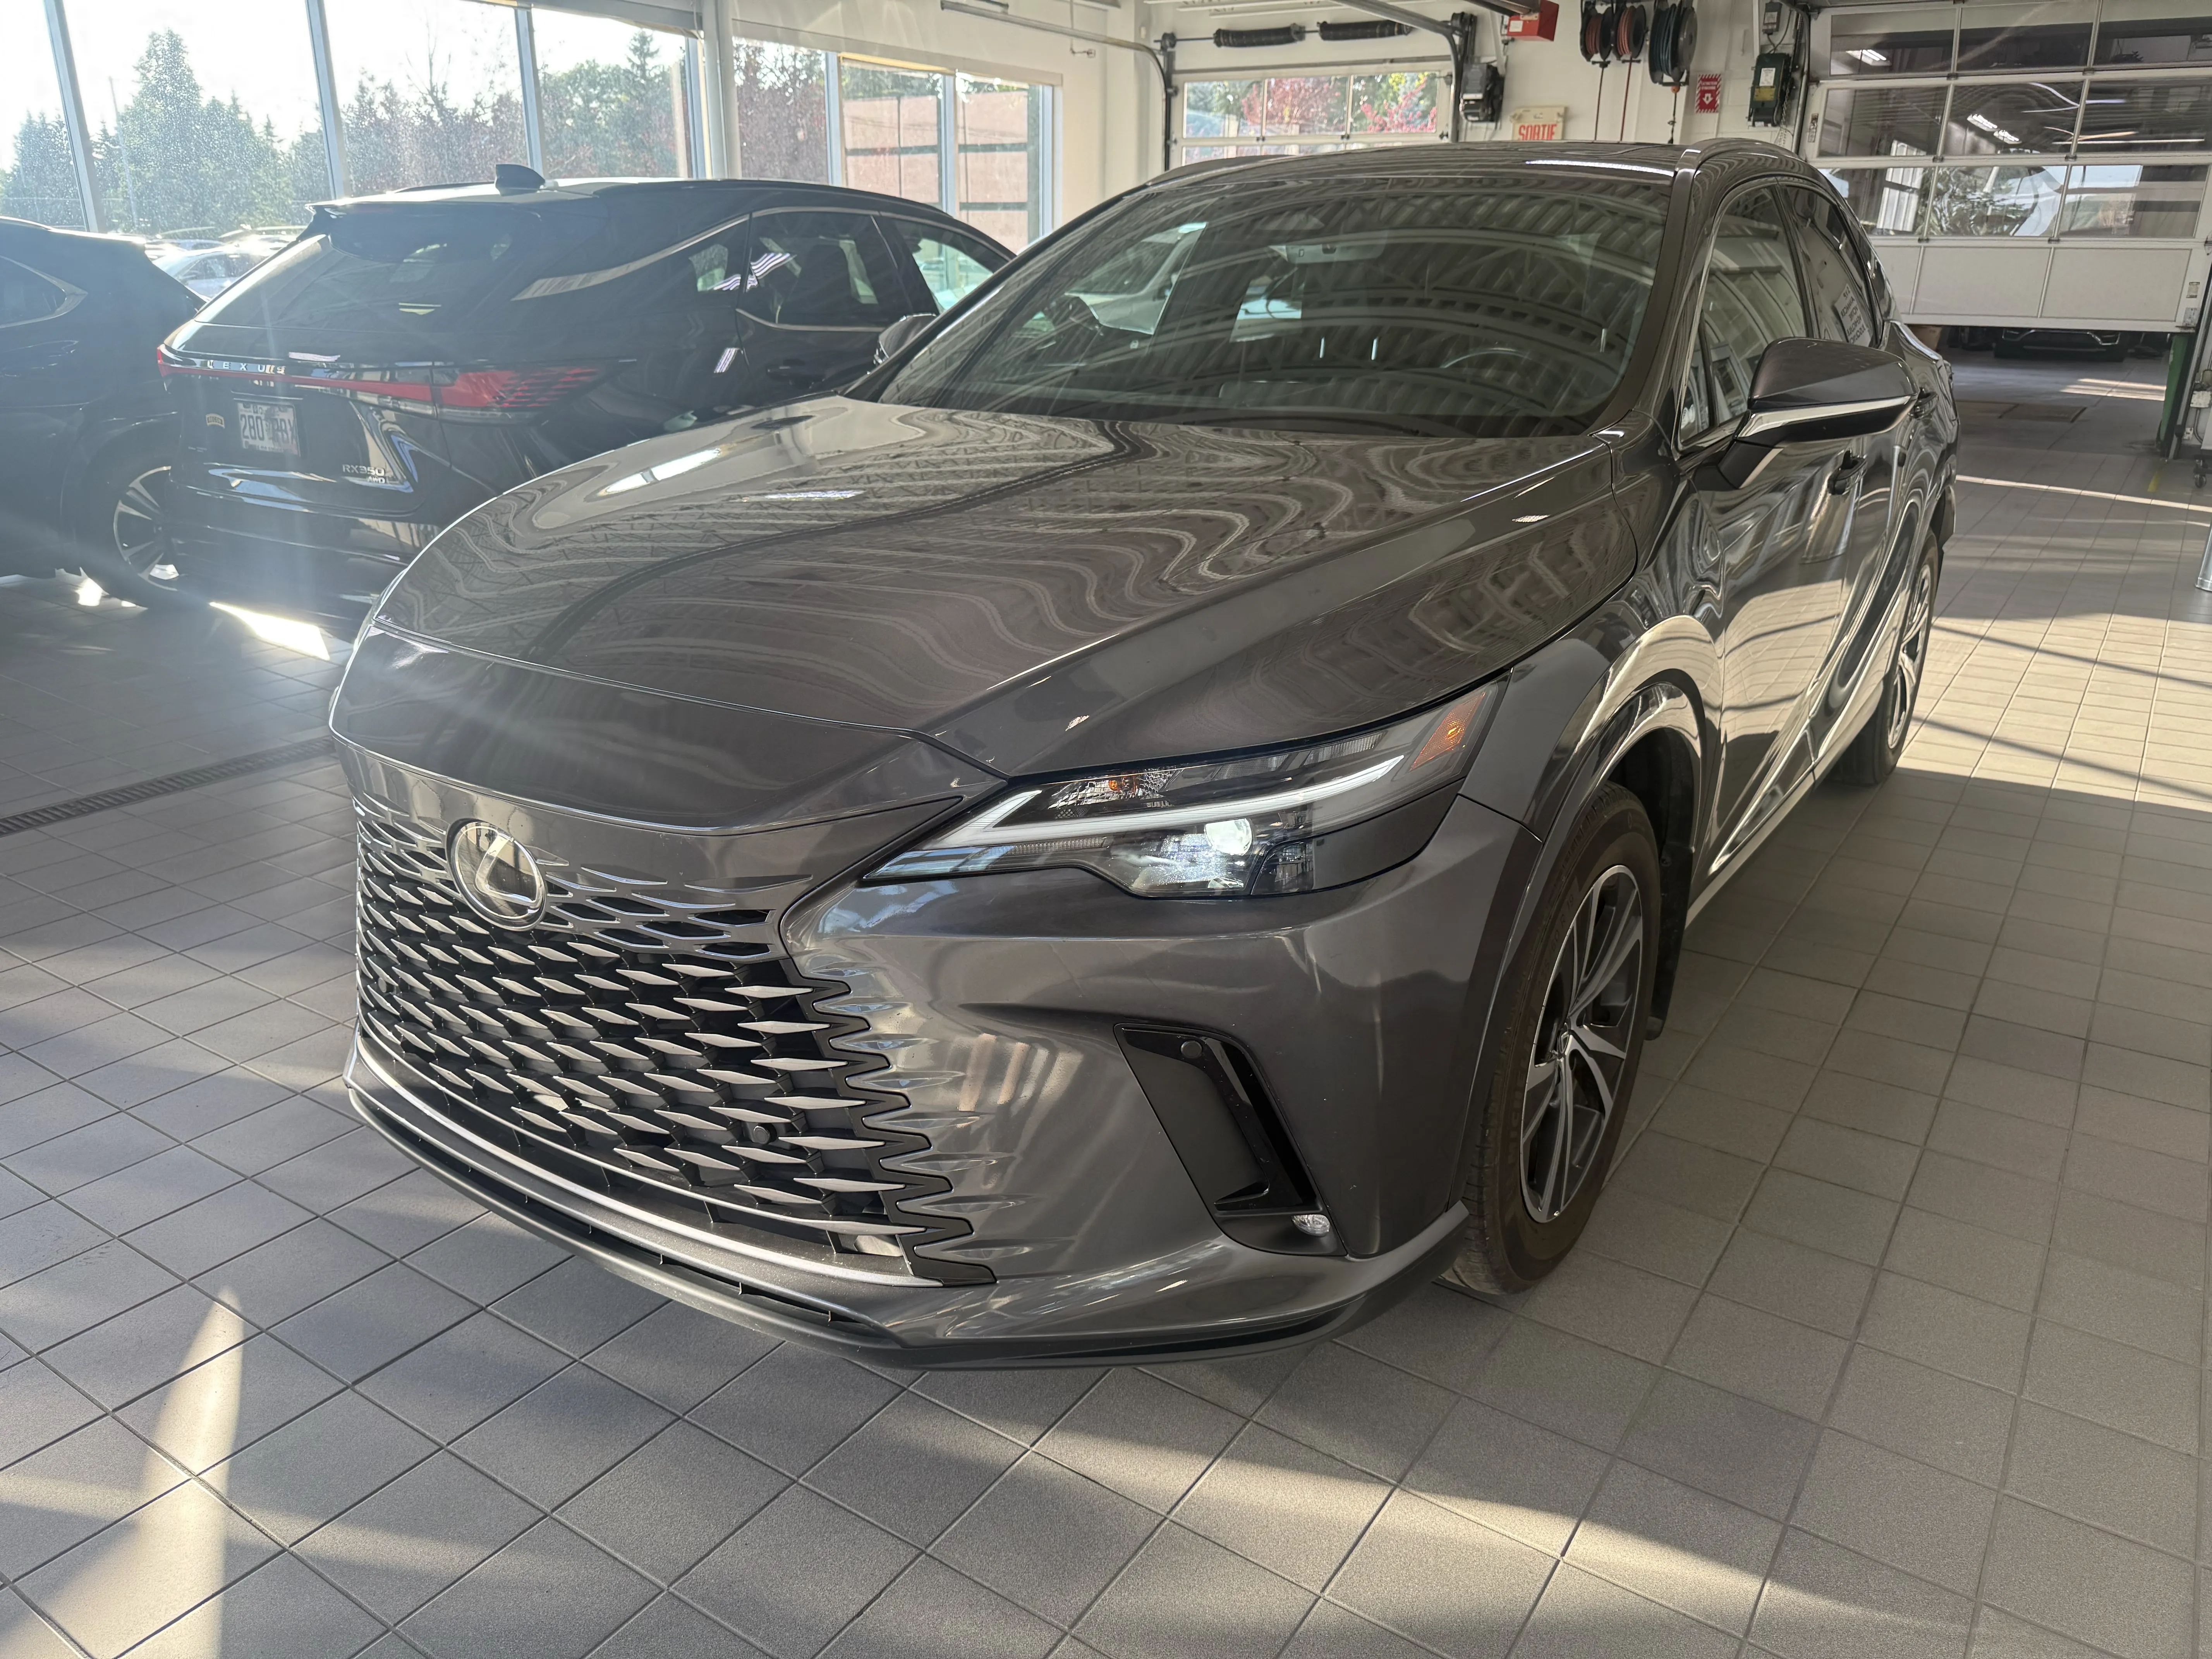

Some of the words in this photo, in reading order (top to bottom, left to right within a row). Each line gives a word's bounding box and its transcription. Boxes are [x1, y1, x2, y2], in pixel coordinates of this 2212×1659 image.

[207, 360, 285, 374] LEXUS
[240, 414, 264, 441] 280
[368, 476, 385, 484] AWD
[1508, 1017, 1537, 1164] MICHELIN
